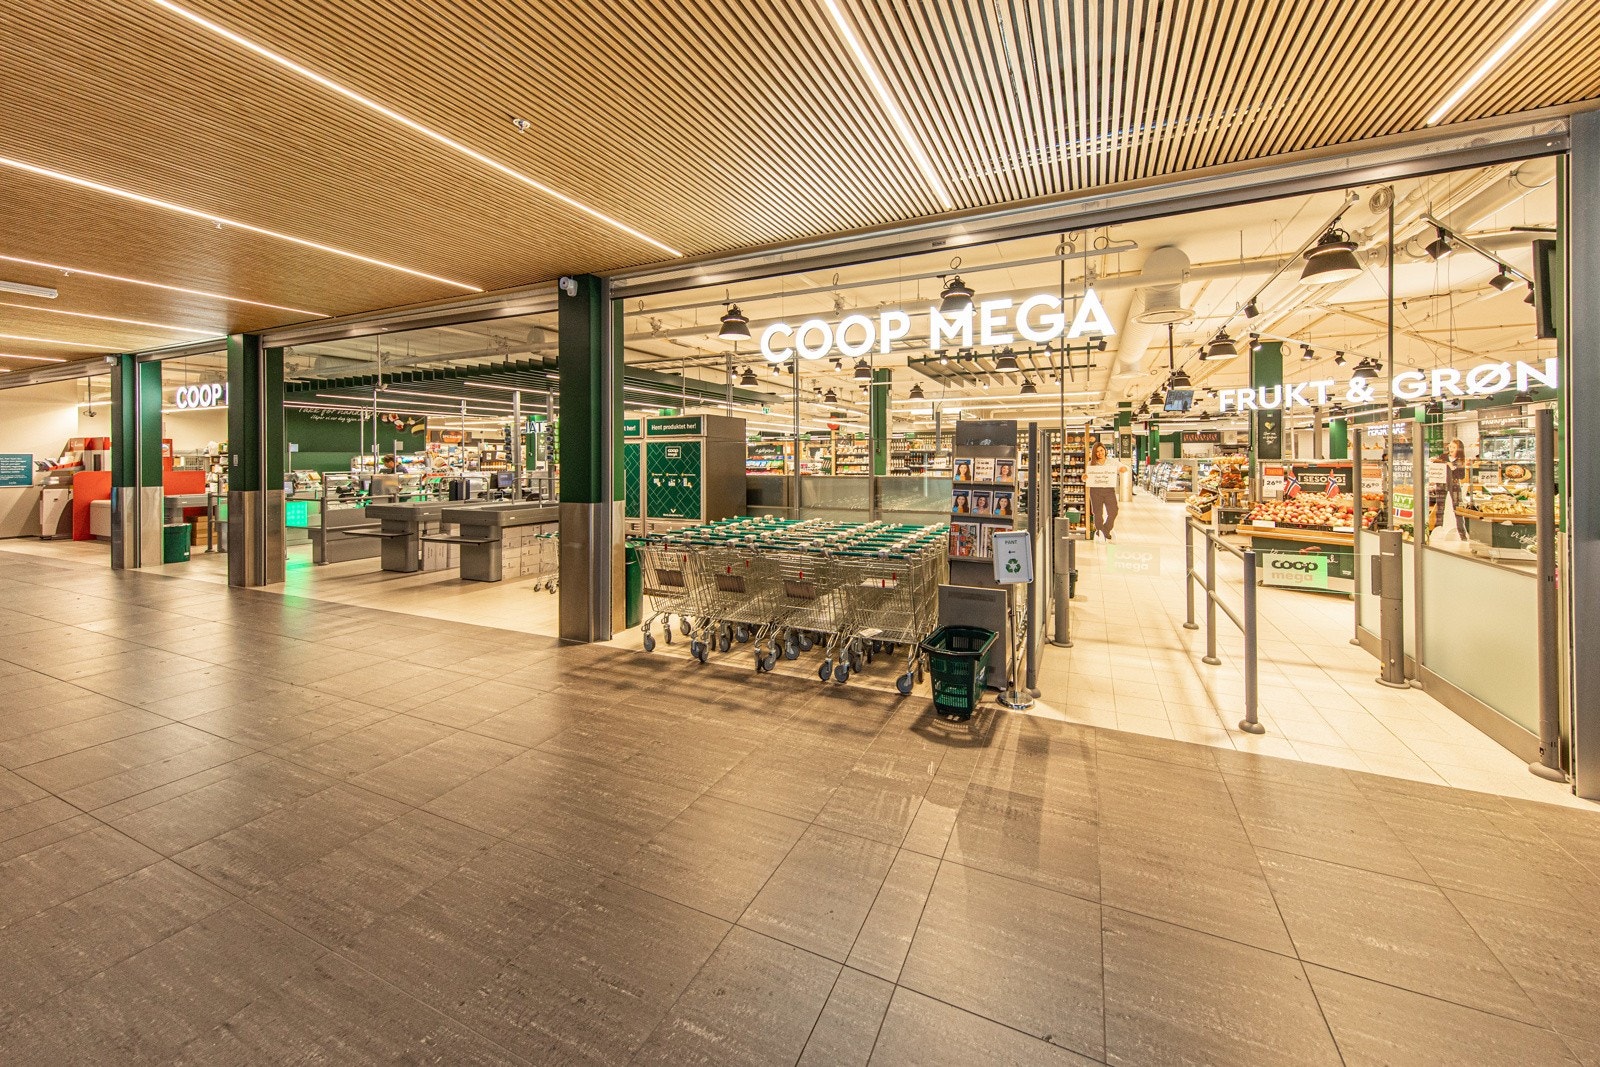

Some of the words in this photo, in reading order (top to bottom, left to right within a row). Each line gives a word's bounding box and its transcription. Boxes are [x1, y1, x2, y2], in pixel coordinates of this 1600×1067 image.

[759, 310, 911, 363] COOP
[929, 287, 1117, 350] MEGA
[1219, 379, 1335, 412] FRUKT
[1345, 376, 1376, 403] &
[1391, 357, 1558, 400] GRØN
[176, 383, 223, 409] COOP
[1303, 474, 1346, 484] SESOG!
[1271, 560, 1319, 573] coop
[1271, 572, 1313, 583] mega
